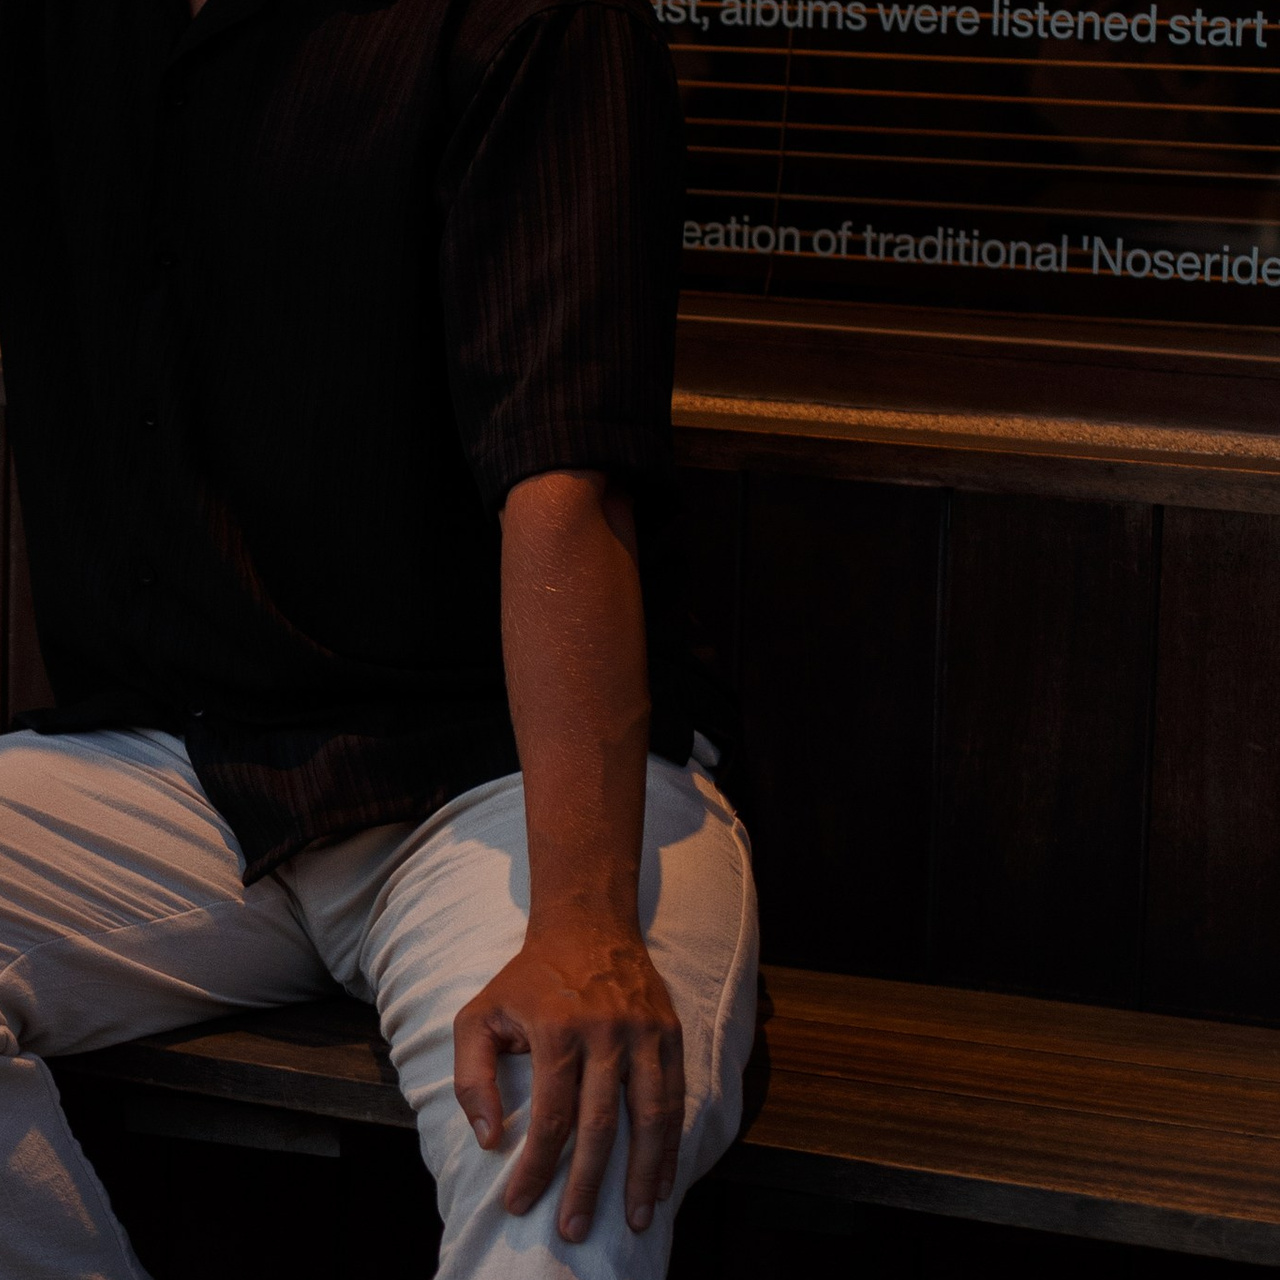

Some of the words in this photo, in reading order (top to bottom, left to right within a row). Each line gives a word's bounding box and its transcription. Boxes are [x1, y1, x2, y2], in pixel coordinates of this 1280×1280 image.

[876, 0, 981, 37] were
[1167, 7, 1268, 48] start
[812, 219, 853, 258] of
[863, 223, 1069, 273] traditional
